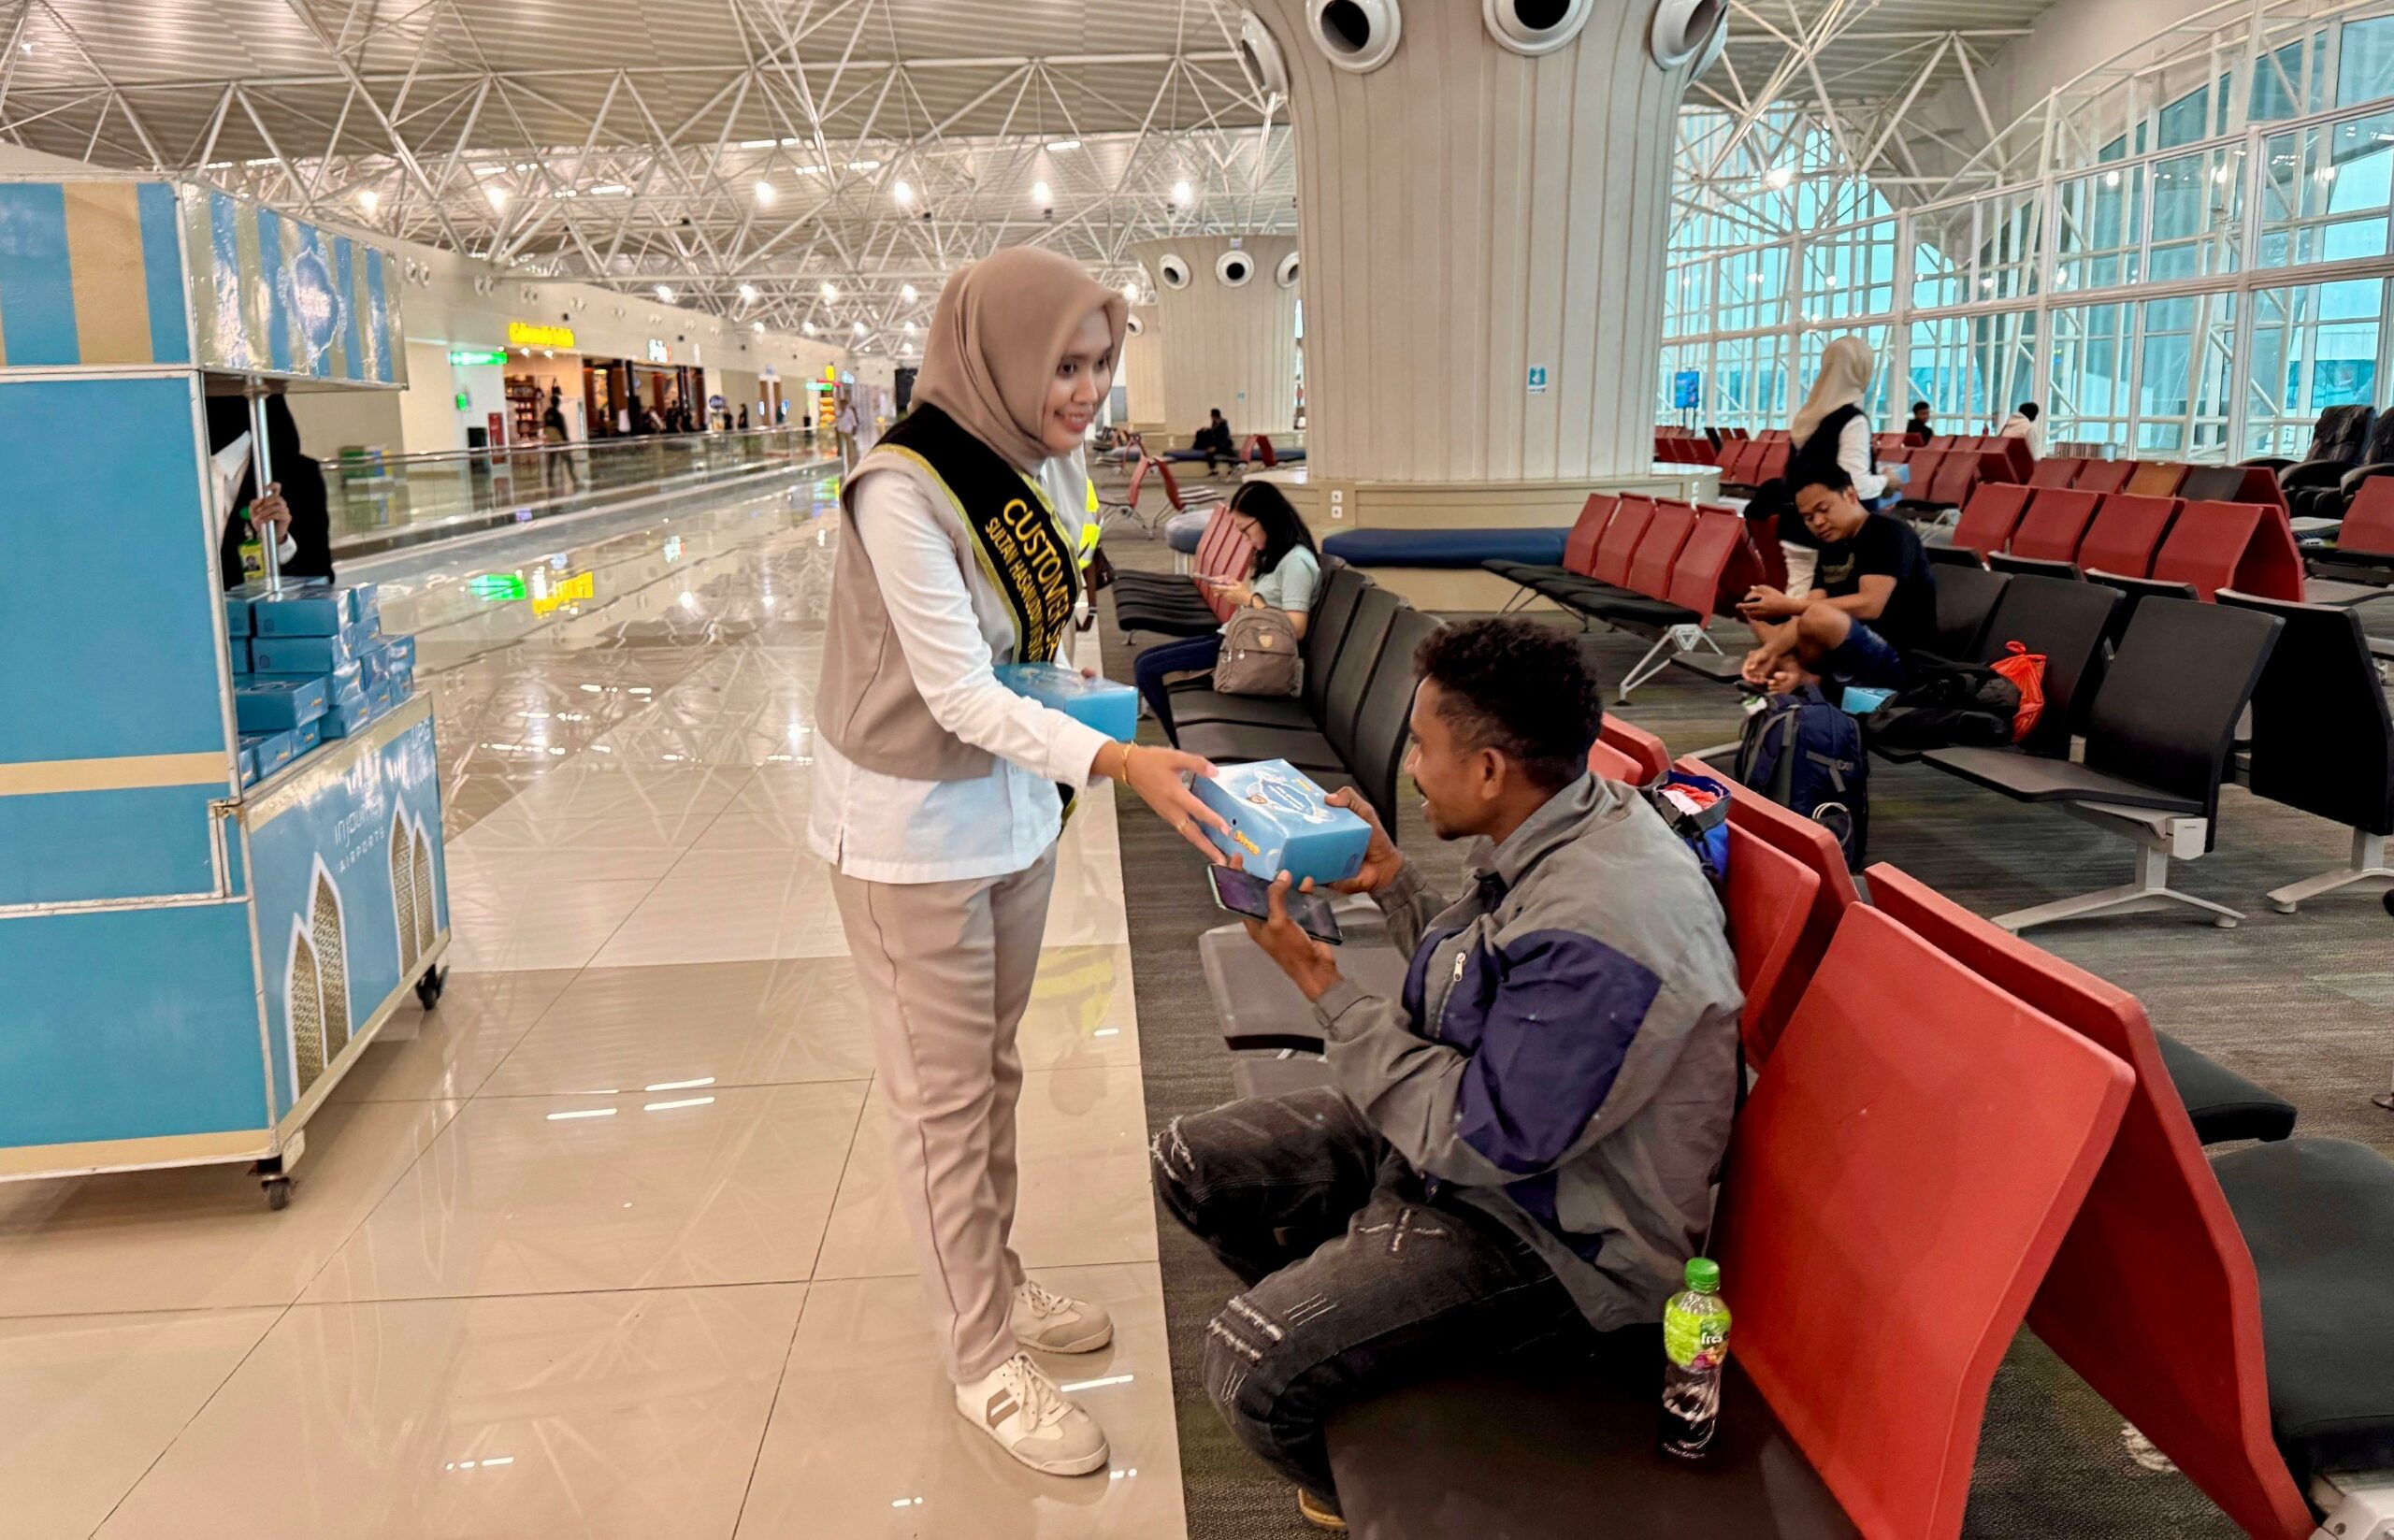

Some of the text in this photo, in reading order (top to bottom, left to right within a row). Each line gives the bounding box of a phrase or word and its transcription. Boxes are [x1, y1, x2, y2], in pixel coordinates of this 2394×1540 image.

[985, 516, 1020, 567] SULTAN
[1003, 498, 1070, 628] CUSTOMER
[339, 826, 385, 874] AIRPORTS
